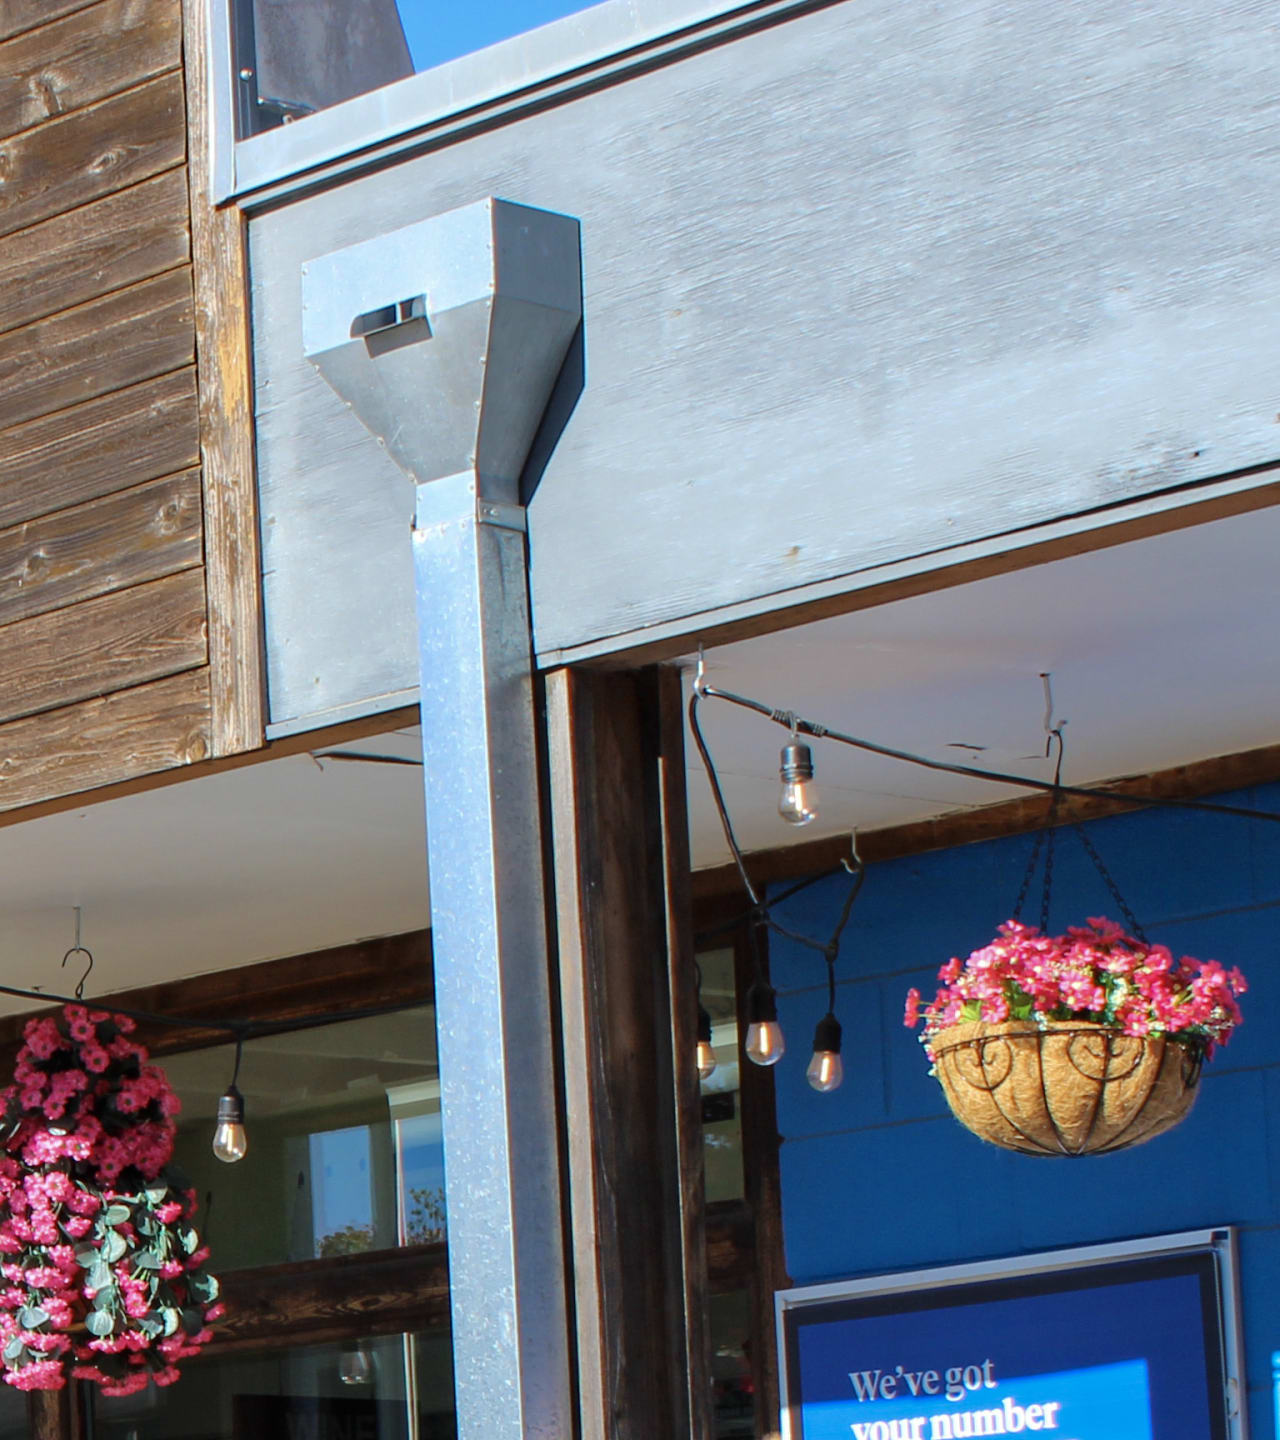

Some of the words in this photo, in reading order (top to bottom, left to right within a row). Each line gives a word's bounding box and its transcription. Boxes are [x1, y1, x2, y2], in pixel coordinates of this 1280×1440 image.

[848, 1366, 940, 1403] We've
[945, 1359, 996, 1402] got
[930, 1397, 1060, 1440] number
